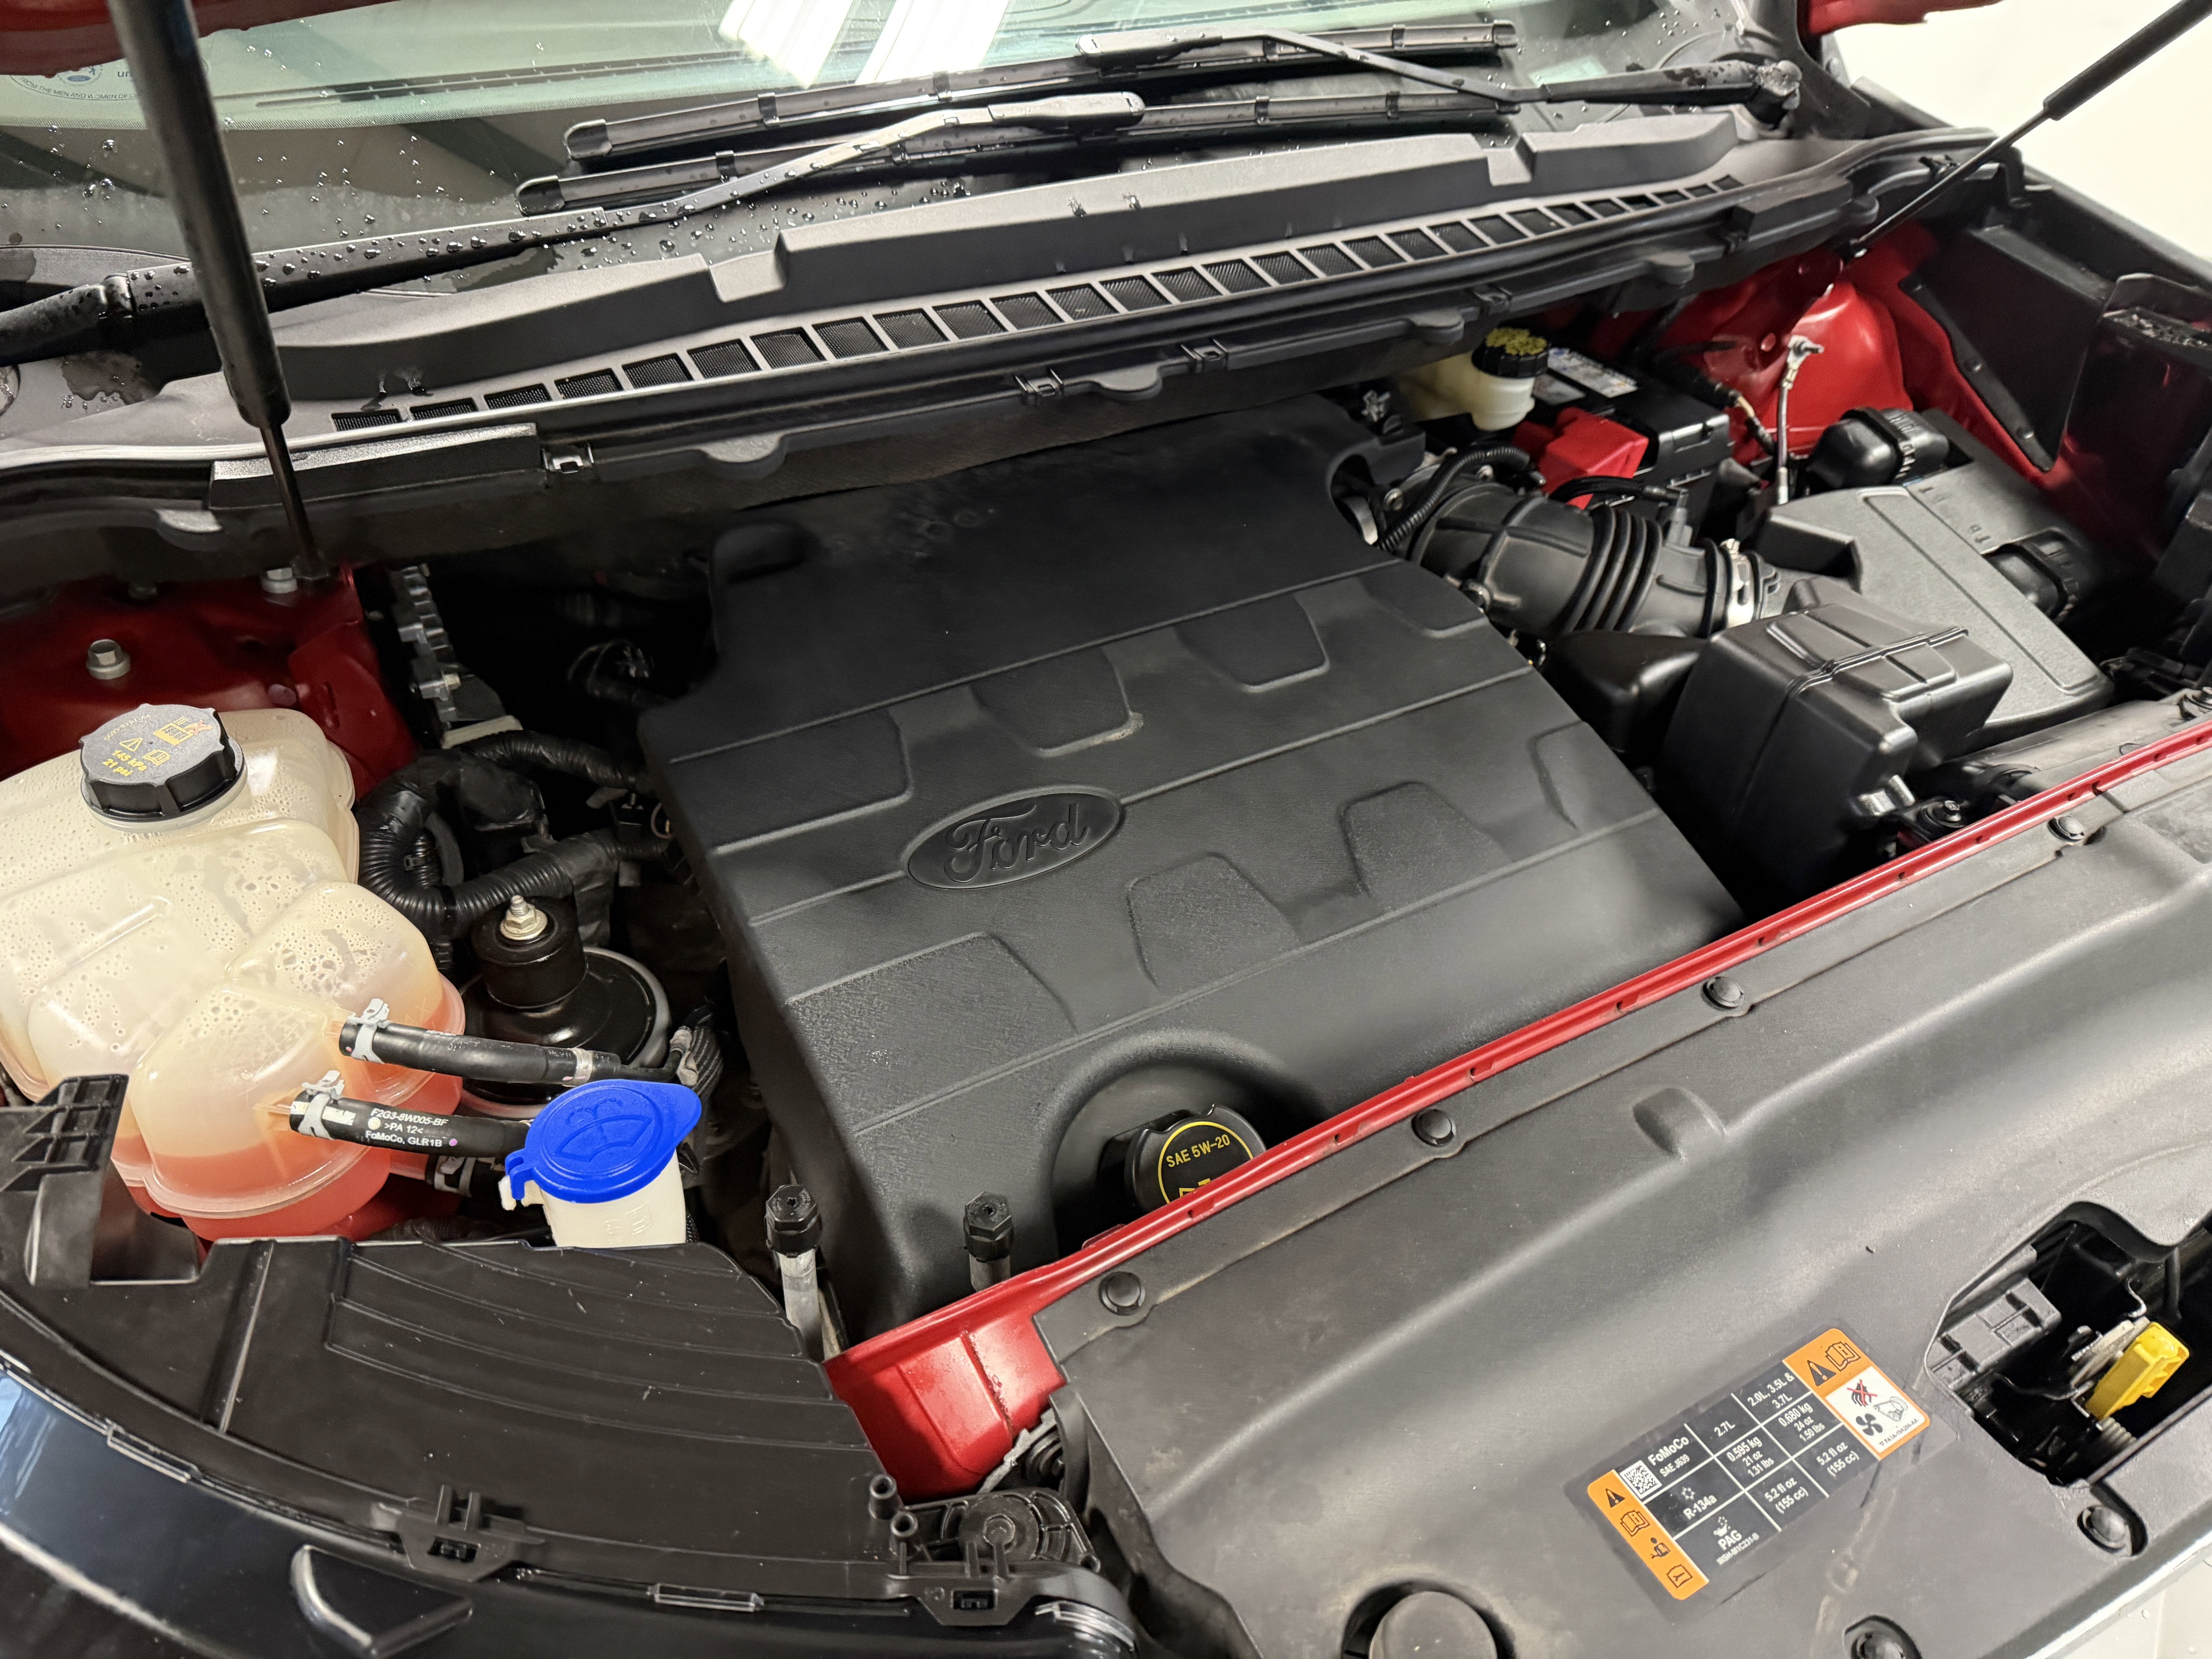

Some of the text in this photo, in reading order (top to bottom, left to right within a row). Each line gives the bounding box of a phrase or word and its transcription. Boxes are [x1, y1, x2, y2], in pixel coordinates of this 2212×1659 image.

[19, 76, 38, 89] FROM
[38, 85, 52, 93] THE
[102, 759, 134, 776] 21 psi
[112, 750, 147, 772] 145 kPa
[943, 803, 1090, 883] Ford
[384, 1122, 424, 1134] >PA 12<
[407, 1137, 443, 1147] GLR1B
[1166, 1134, 1230, 1168] SAE 5W-20
[1747, 1372, 1795, 1407] 2.0L, 3.5L &
[1772, 1393, 1793, 1409] 3.7L
[1778, 1402, 1814, 1427] 0.680 kg
[1793, 1416, 1814, 1432] 24 oz
[1714, 1420, 1736, 1437] 2.7L
[1799, 1422, 1826, 1442] 1.50 lbs
[1648, 1437, 1689, 1466] FoMoCo
[1726, 1436, 1762, 1462] 0.595 kg
[1742, 1451, 1763, 1467] 21 oz
[1816, 1442, 1848, 1466] 5.2 fl oz
[1660, 1454, 1690, 1477] SAE J639
[1747, 1457, 1775, 1477] 1.31 lbs
[1827, 1450, 1860, 1478] (155 cc)
[1764, 1477, 1797, 1502] 5.2 fl oz
[1775, 1486, 1809, 1514] (155 cc)
[1683, 1494, 1717, 1520] R-134a
[1717, 1530, 1742, 1551] PAG
